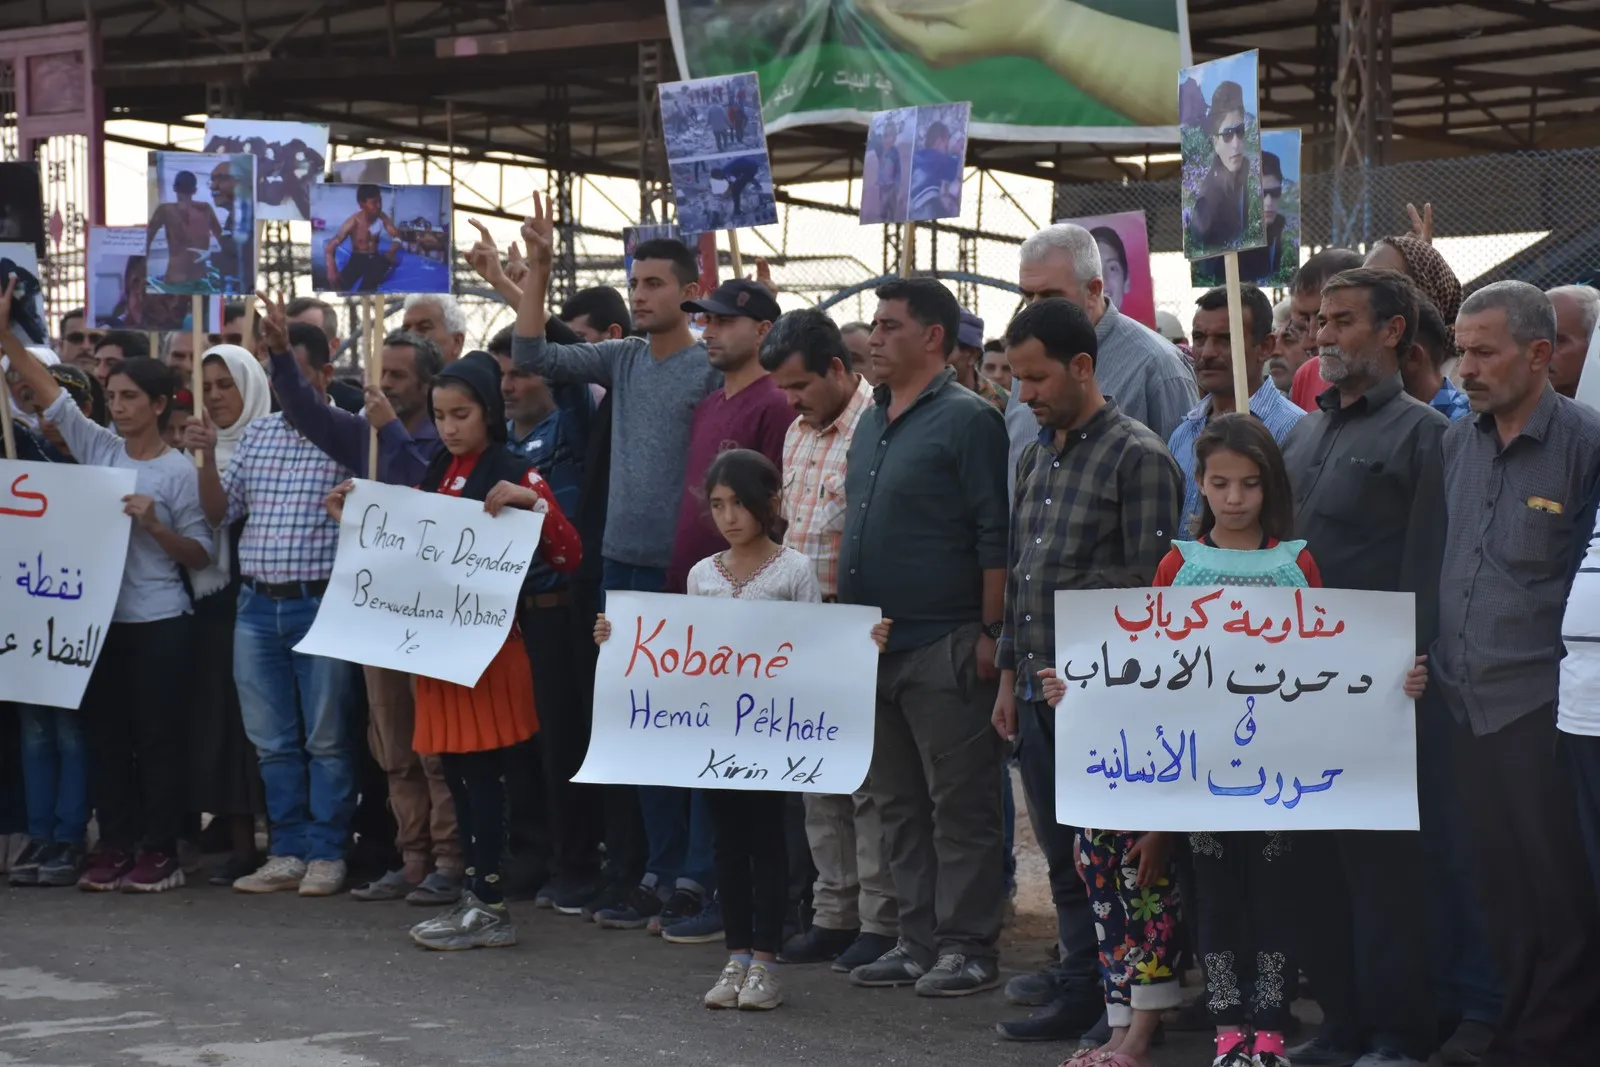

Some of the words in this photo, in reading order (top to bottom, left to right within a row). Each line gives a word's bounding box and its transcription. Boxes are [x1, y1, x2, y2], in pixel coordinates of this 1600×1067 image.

[416, 519, 445, 563] Tev
[451, 528, 526, 577] Deyndarê
[16, 552, 82, 600] نقطة
[353, 569, 443, 618] Berxwedana
[1115, 589, 1224, 642] كوباني
[1223, 589, 1344, 644] مقاومة
[32, 616, 100, 667] للقضاء
[630, 689, 710, 729] Hemû
[698, 748, 768, 780] Kirin
[781, 756, 823, 784] Yek
[1208, 758, 1344, 809] حررت
